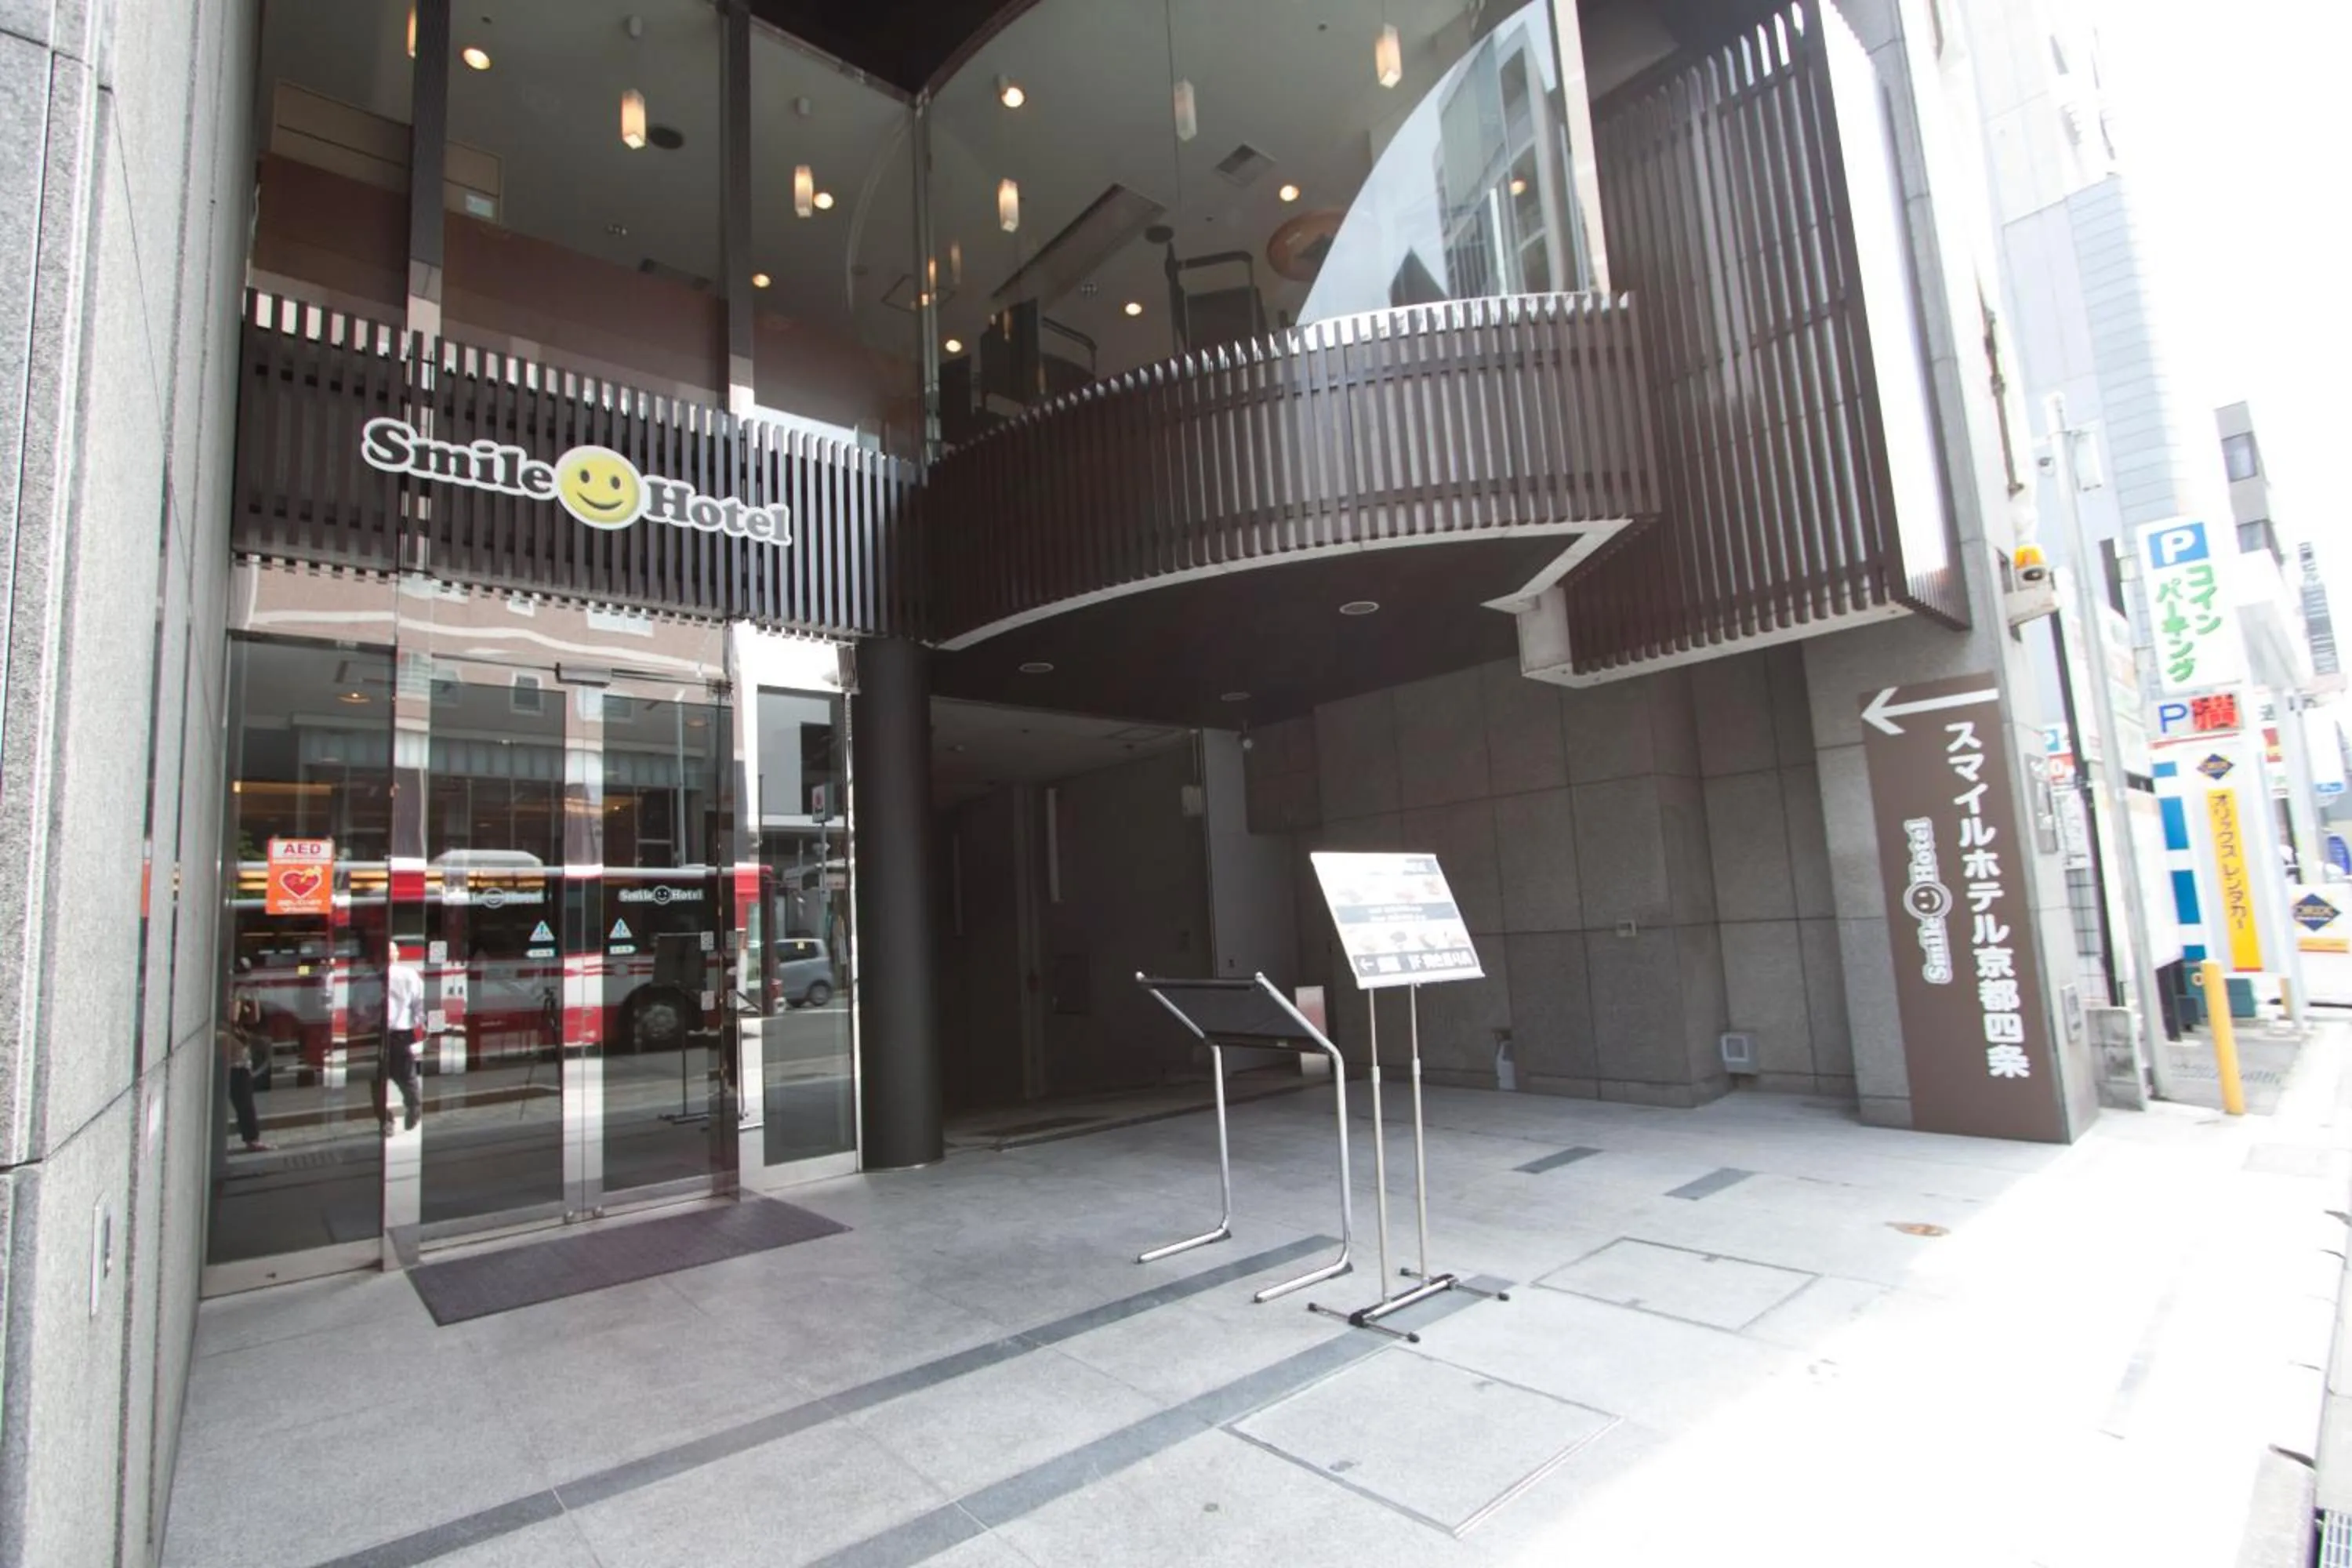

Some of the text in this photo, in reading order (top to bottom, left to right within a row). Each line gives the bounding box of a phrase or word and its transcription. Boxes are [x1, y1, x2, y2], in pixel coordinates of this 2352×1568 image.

[363, 419, 792, 546] Smile Hotel
[2161, 528, 2195, 564] P
[2156, 578, 2196, 683] パーキング
[2187, 564, 2222, 635] コイン
[2158, 703, 2187, 734] P
[284, 843, 321, 855] AED
[670, 888, 703, 901] Hotel
[1905, 818, 1952, 983] Smile Hotel
[1945, 721, 2030, 1078] スマイルホテル京都四条
